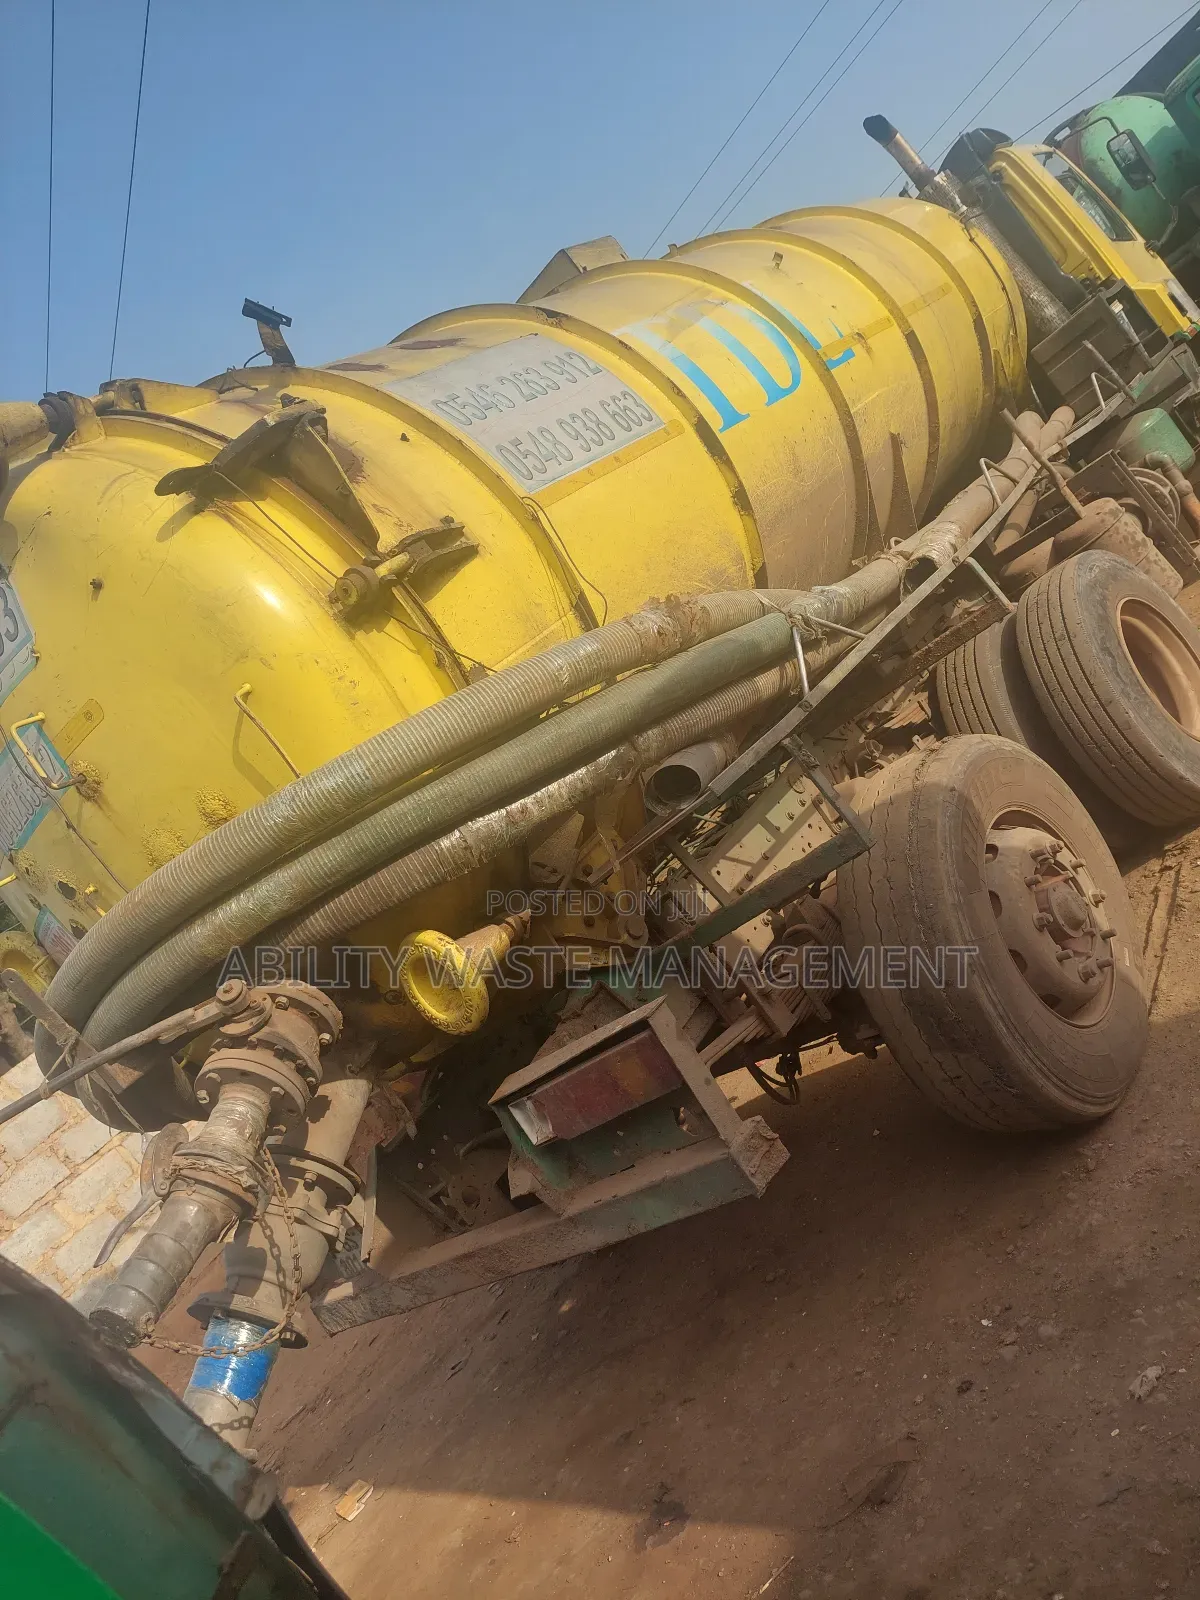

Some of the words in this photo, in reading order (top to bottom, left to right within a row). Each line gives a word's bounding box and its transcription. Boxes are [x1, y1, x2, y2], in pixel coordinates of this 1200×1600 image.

[431, 383, 516, 426] 0546
[496, 367, 561, 403] 263
[541, 351, 603, 384] 912
[495, 426, 574, 481] 0548
[556, 407, 616, 453] 938
[599, 390, 654, 433] 663
